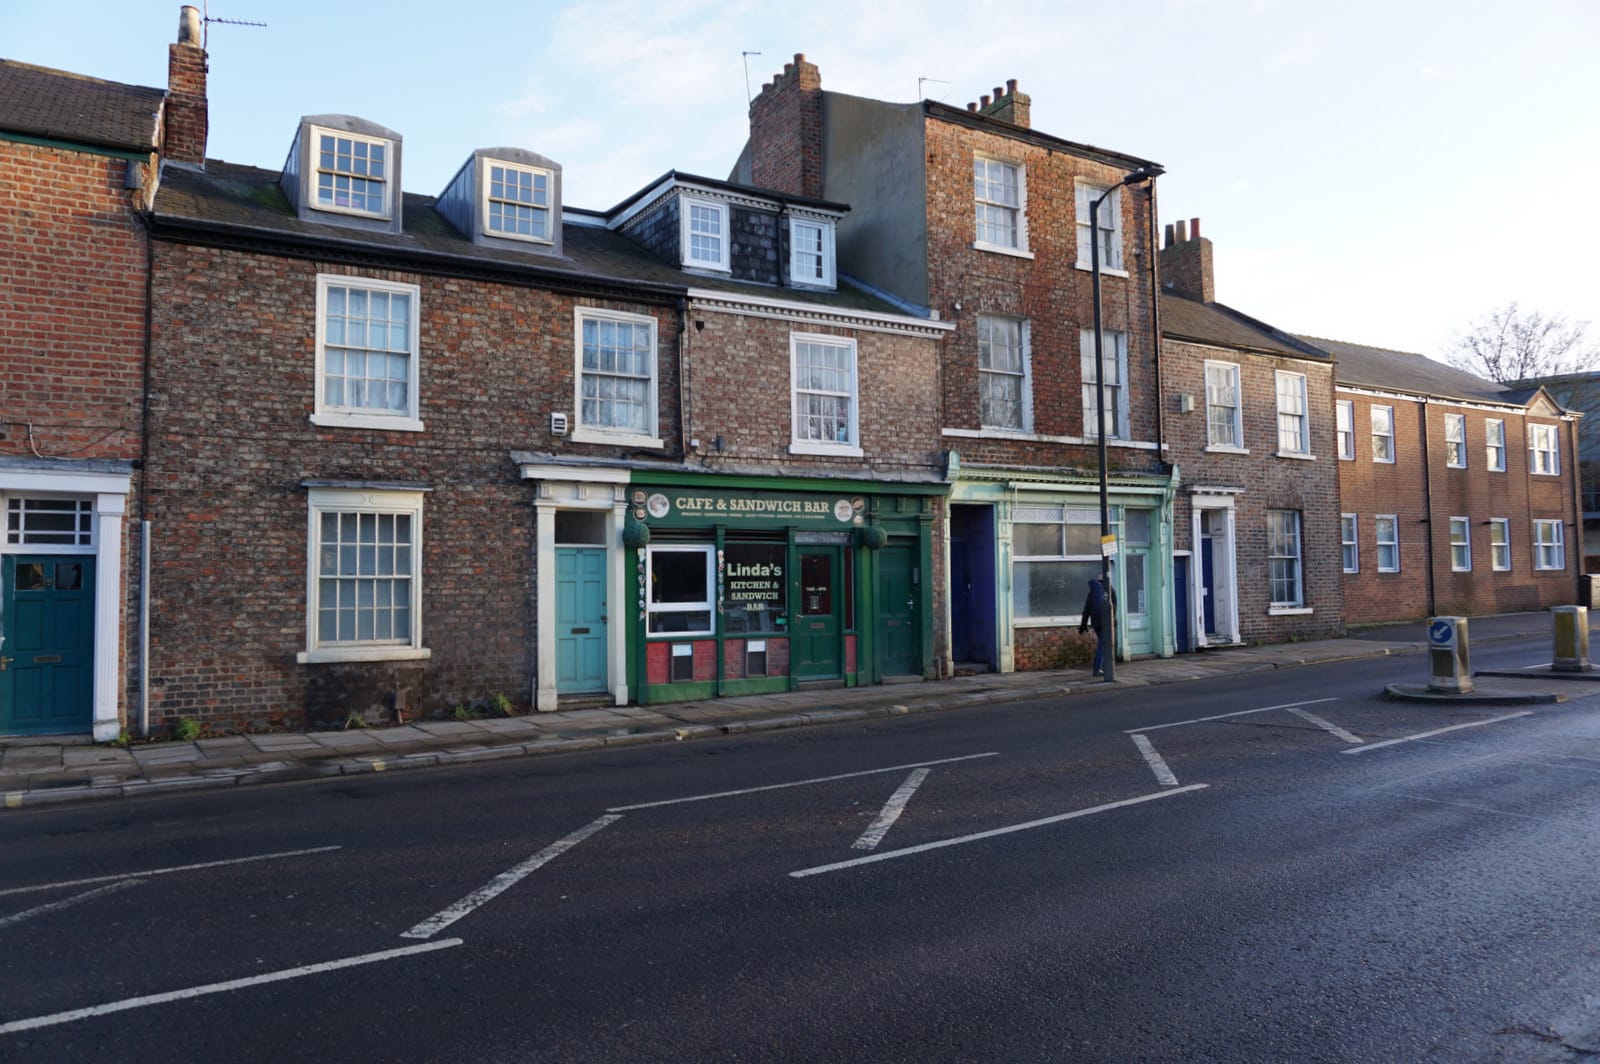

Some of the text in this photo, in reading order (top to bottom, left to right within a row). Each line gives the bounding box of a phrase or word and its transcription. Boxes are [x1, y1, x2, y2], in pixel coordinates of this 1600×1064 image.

[676, 498, 830, 513] CAFE & SANDWICH BAR
[727, 563, 782, 577] Linda's
[730, 581, 779, 589] KITCHEN &
[731, 592, 779, 600] SANDWICH
[746, 602, 765, 611] BAR
